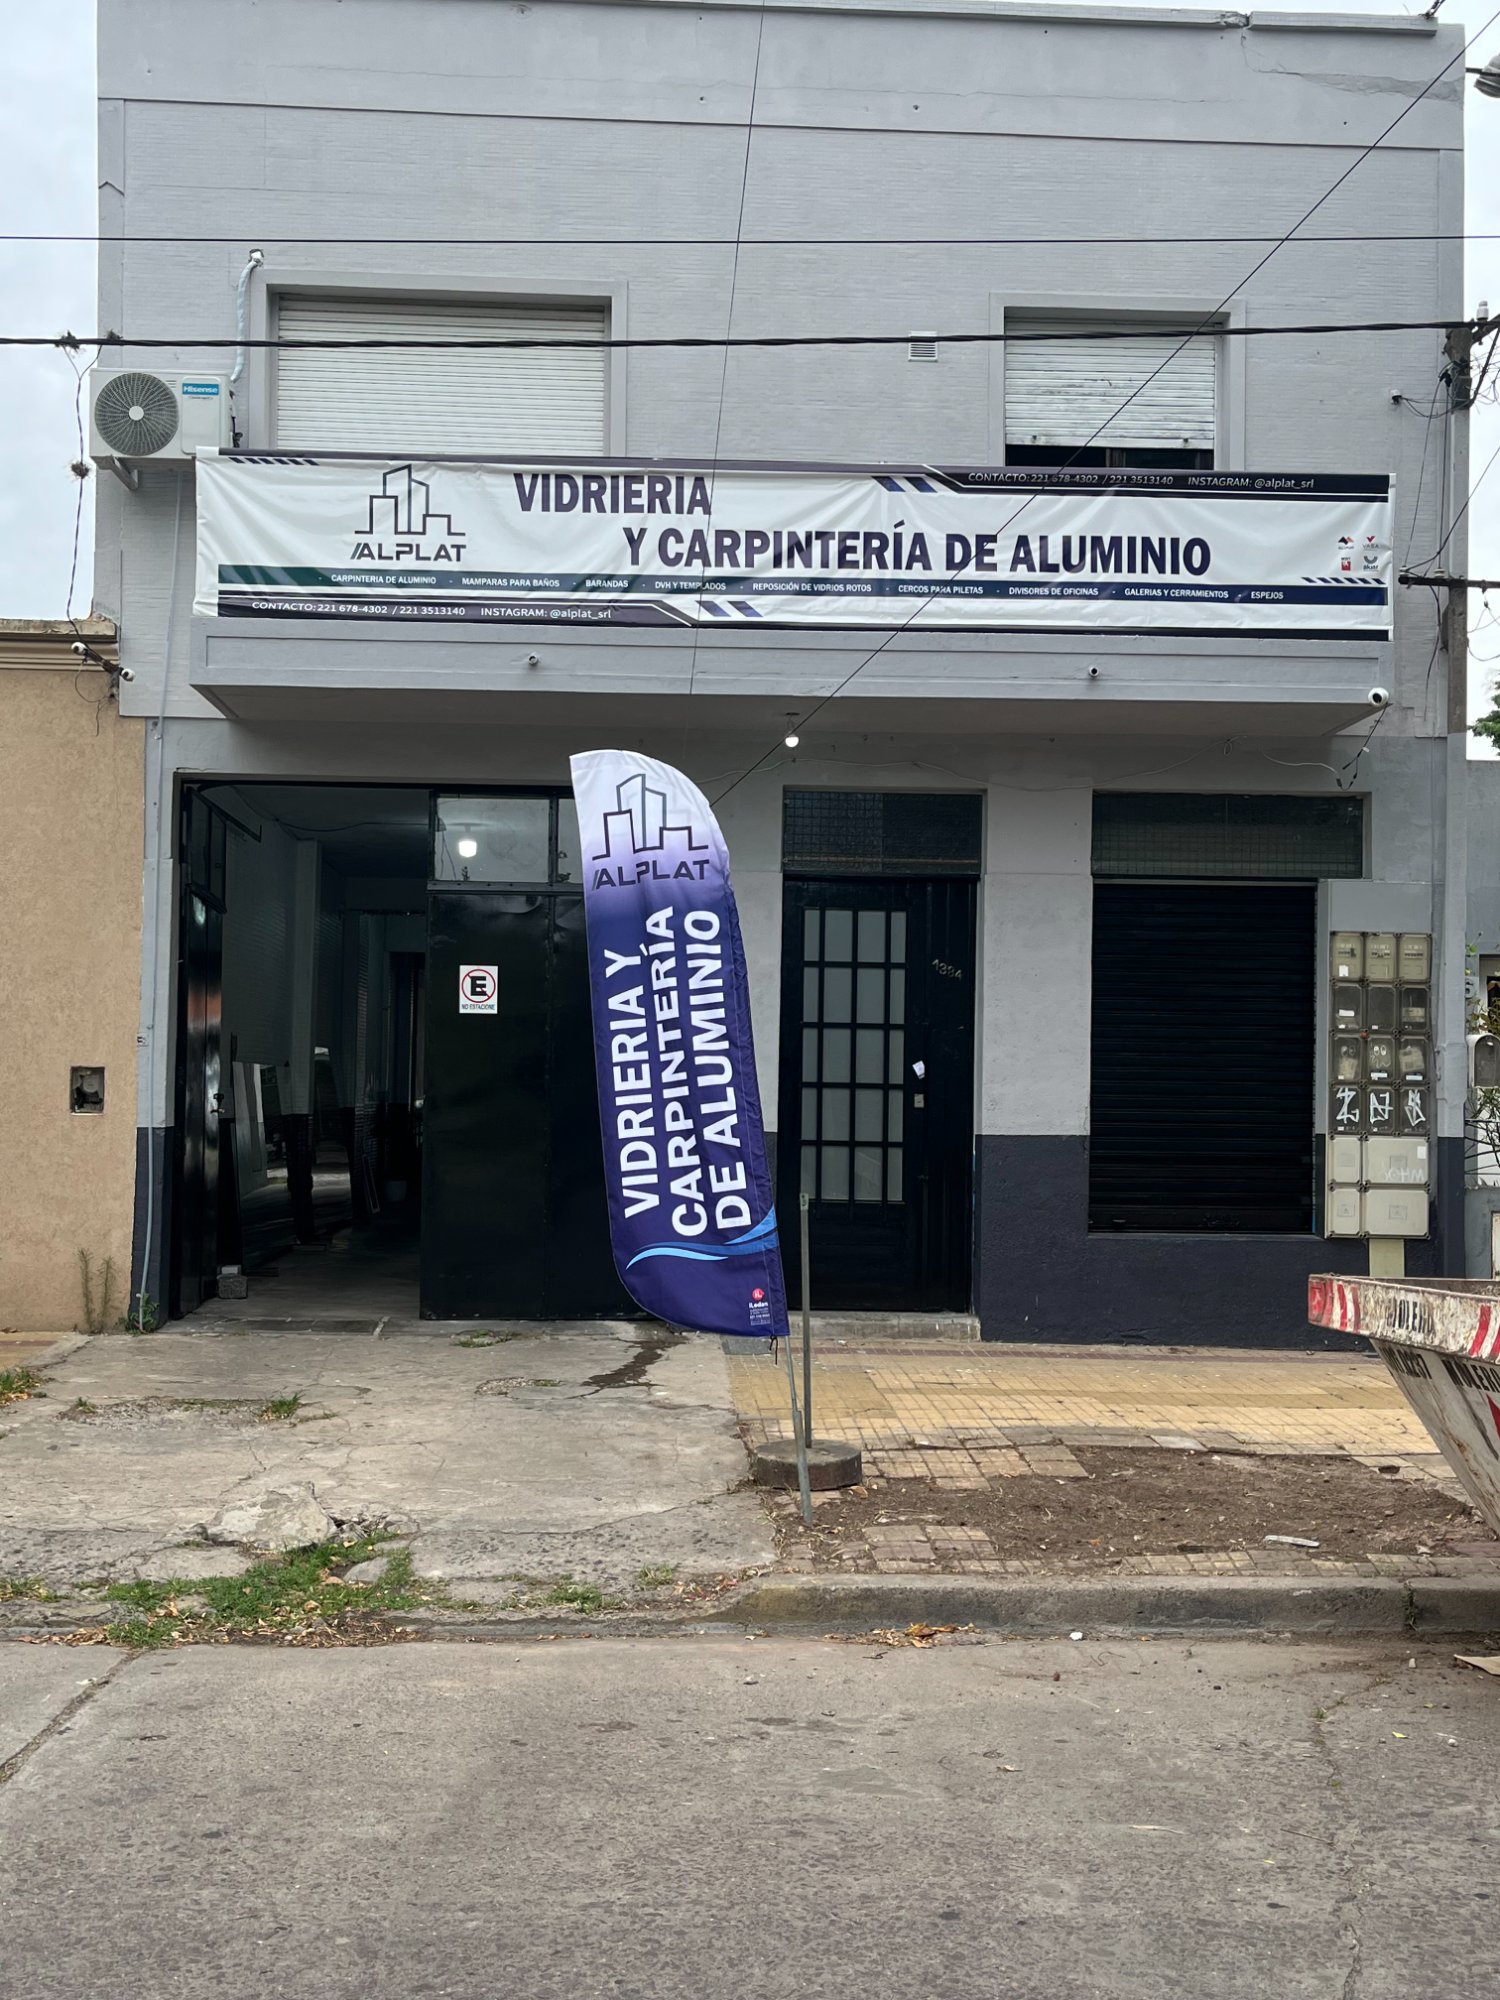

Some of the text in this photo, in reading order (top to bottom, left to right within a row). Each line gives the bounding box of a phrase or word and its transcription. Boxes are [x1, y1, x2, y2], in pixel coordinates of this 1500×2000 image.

[1130, 475, 1174, 485] 3513140
[1187, 477, 1314, 490] INSTAGRAM: @alplat_srl
[513, 472, 712, 516] VIDRIERIA
[622, 519, 1211, 577] Y CARPINTERÍA DE ALUMINIO
[331, 574, 384, 583] CARPINTERIA
[398, 576, 437, 585] ALUMINIO
[461, 577, 560, 588] MAMPARAS PARA BAÑOS
[585, 580, 629, 588] BARANDAS
[655, 581, 671, 589] DVH
[672, 581, 678, 589] Y
[752, 581, 872, 592] REPOSICIÓN DE VIDRIOS ROTOS
[898, 585, 929, 593] CERCOS
[953, 586, 984, 594] PILETAS
[1009, 587, 1050, 595] DIVISORES
[1063, 588, 1099, 596] OFICINAS
[1124, 588, 1229, 599] GALERIAS Y CERRAMIENTOS
[1251, 592, 1284, 600] ESPEJOS
[338, 605, 388, 615] 678-4302
[400, 606, 418, 615] 221
[421, 606, 466, 616] 3513140
[481, 607, 611, 620] INSTAGRAM: @alplat_srl
[470, 975, 487, 996] E
[638, 905, 708, 1237] CARPINTERÍA
[683, 910, 752, 1230] DE ALUMINIO
[603, 948, 660, 1219] VIDRIERIA Y
